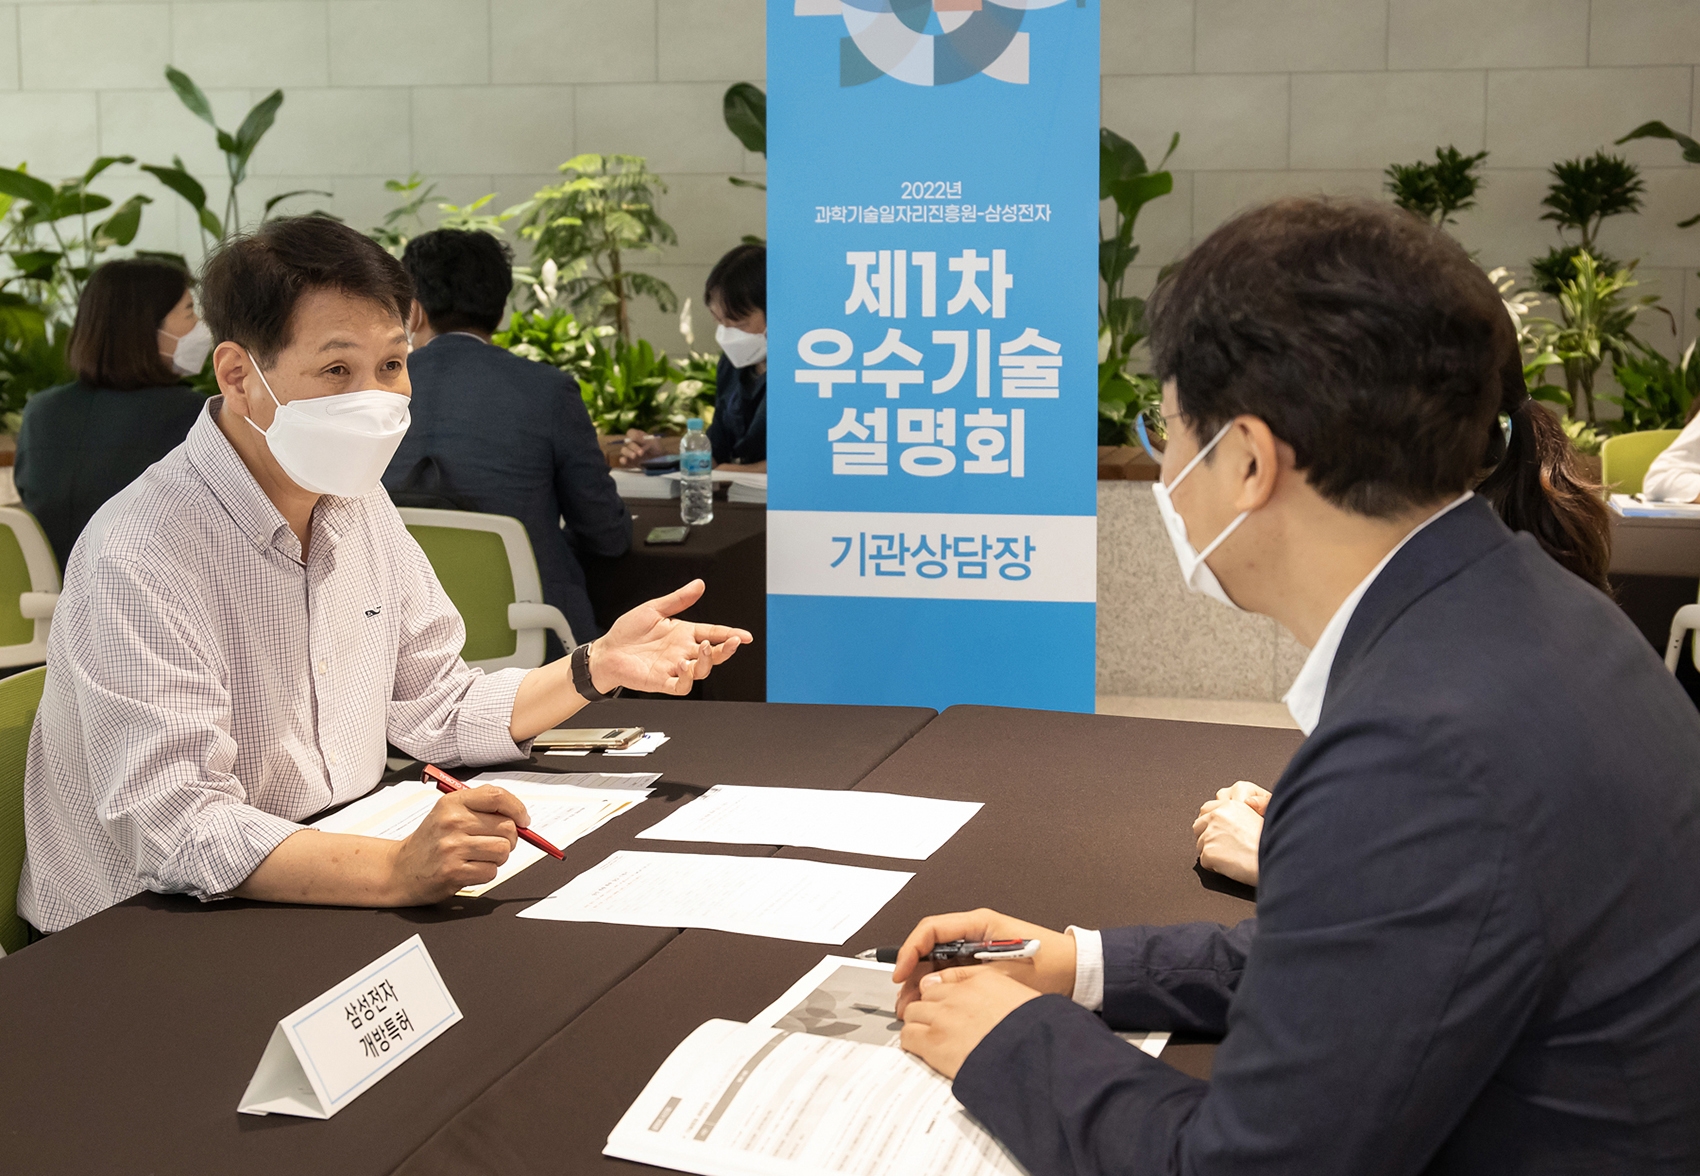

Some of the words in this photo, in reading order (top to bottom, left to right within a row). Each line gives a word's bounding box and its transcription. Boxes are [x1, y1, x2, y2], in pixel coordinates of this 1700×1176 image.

[814, 203, 1052, 224] 과학기술일자리진흥원-삼성전자
[901, 180, 962, 200] 2022년
[844, 248, 1014, 319] 제1차
[794, 327, 1063, 399] 우수기술
[827, 407, 1025, 478] 설명회
[830, 531, 1037, 581] 기관상담장
[344, 978, 399, 1030] 삼성전자
[359, 1008, 415, 1058] 개방특허
